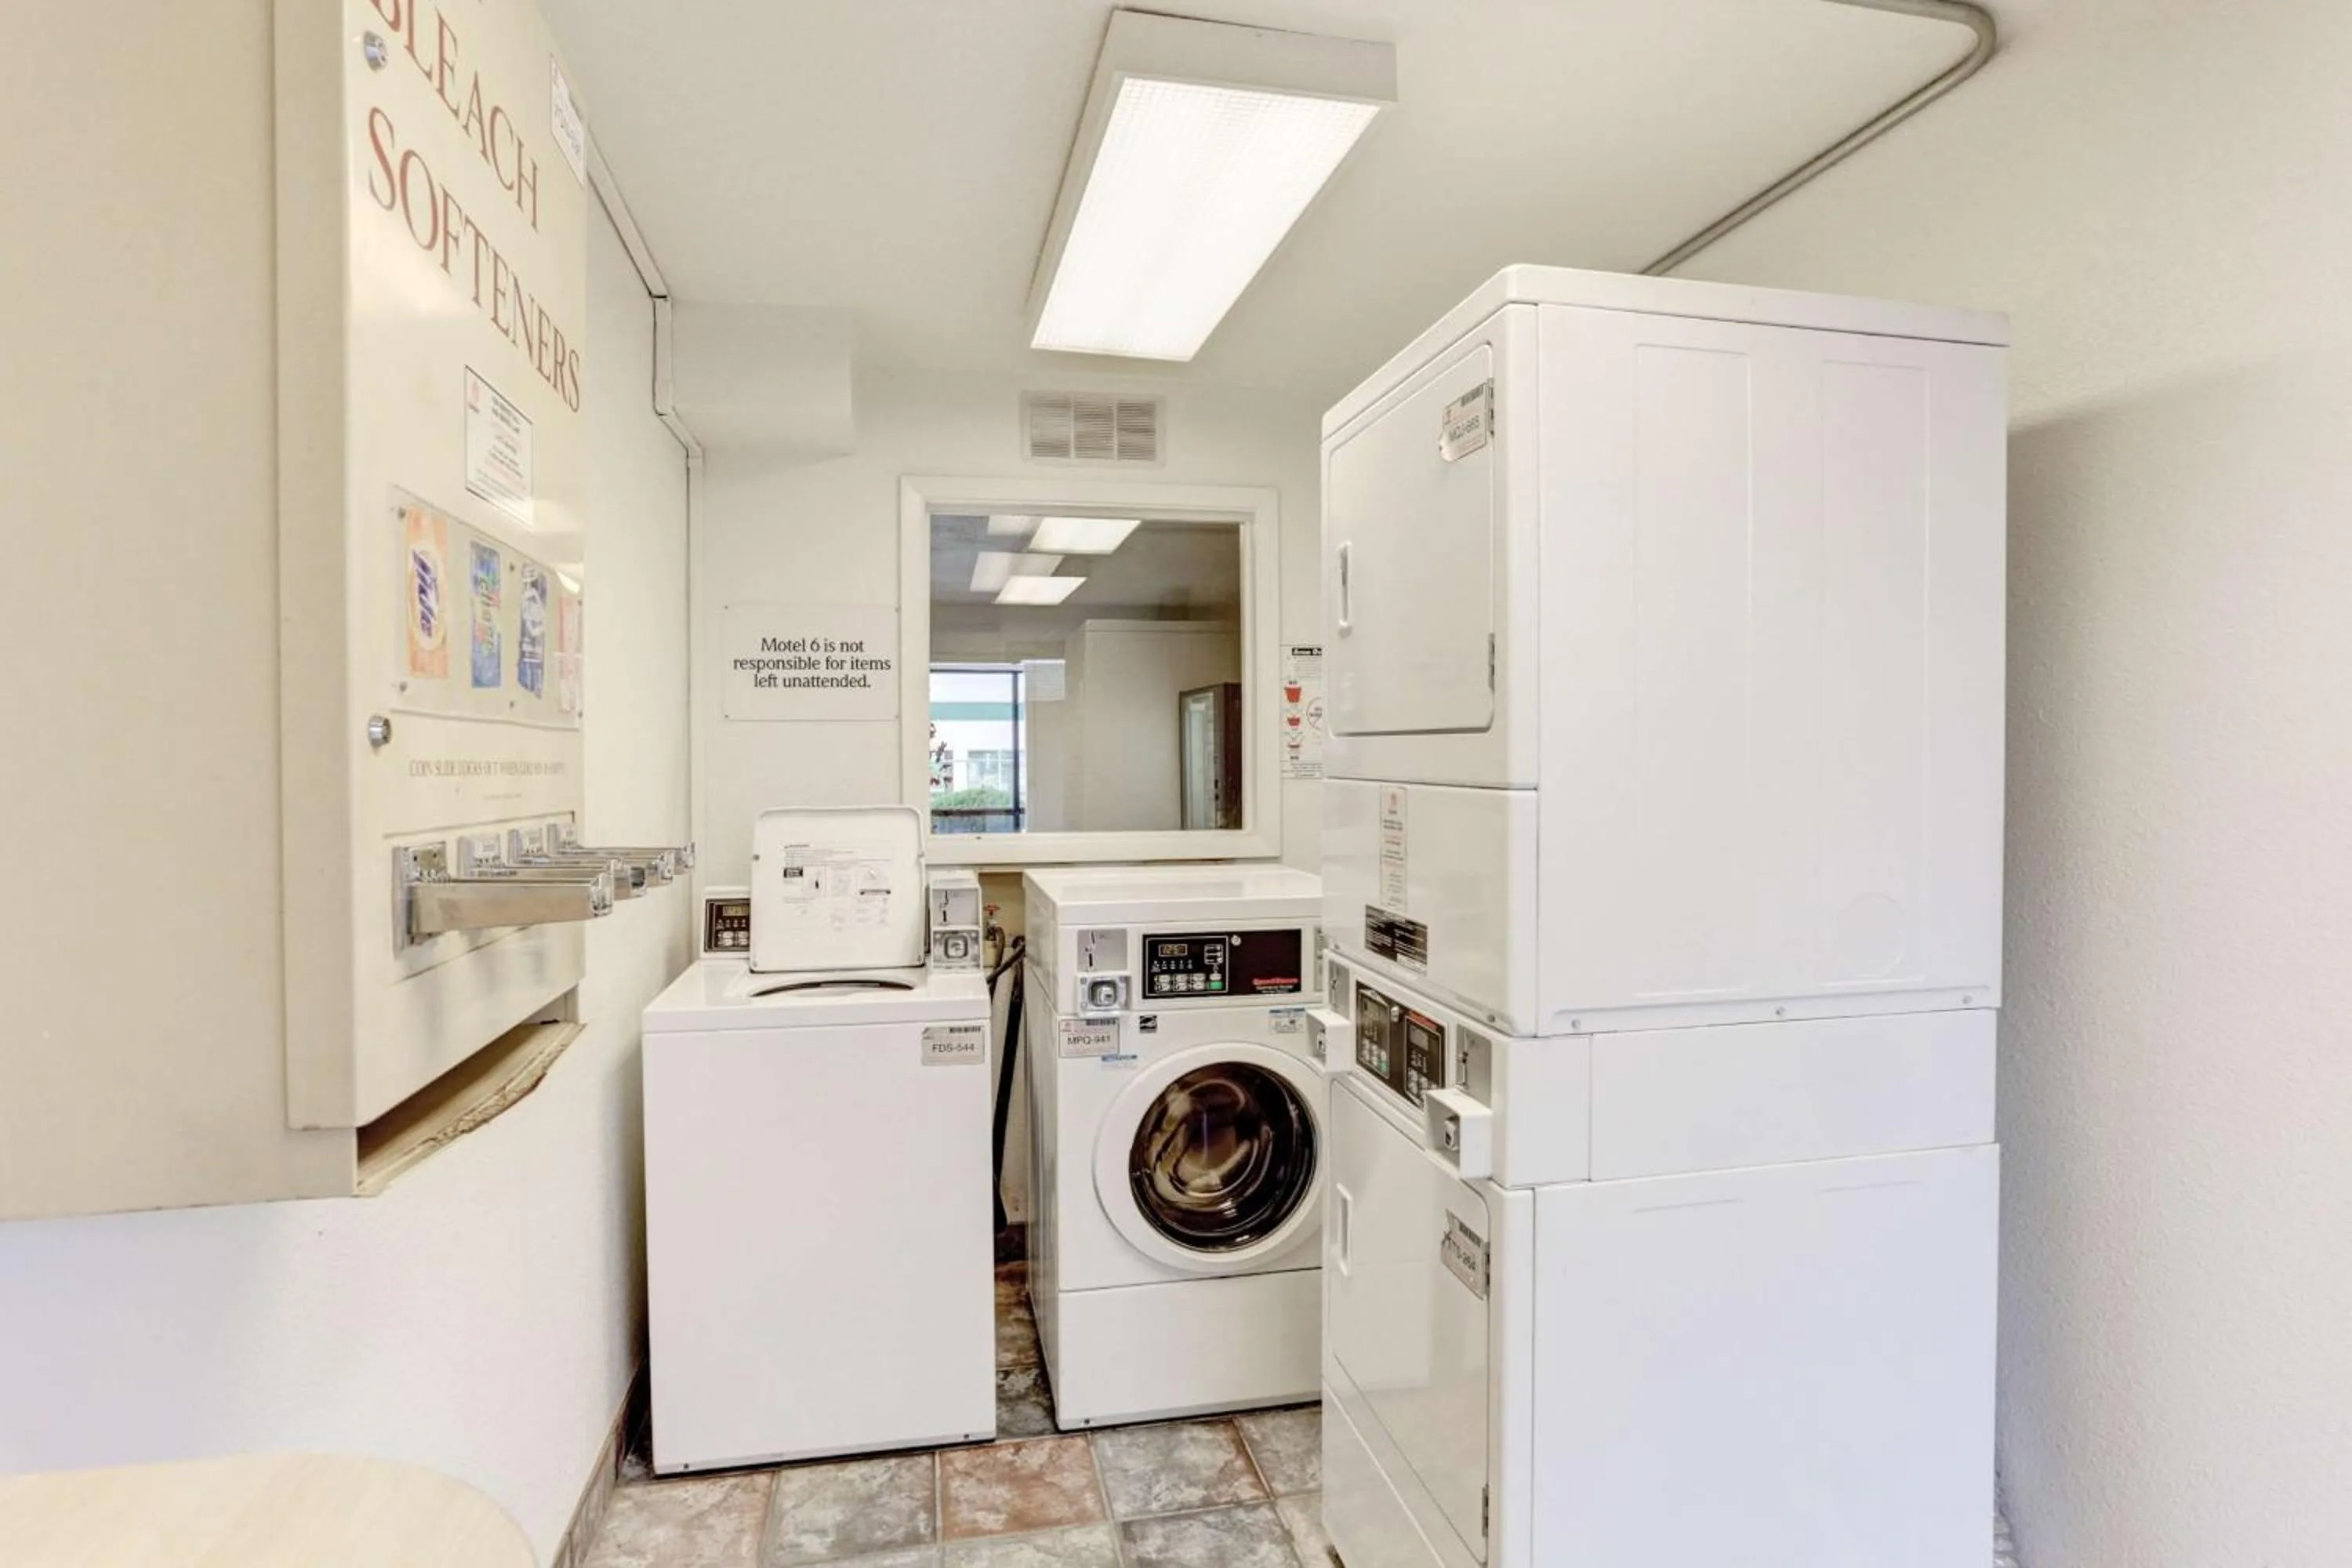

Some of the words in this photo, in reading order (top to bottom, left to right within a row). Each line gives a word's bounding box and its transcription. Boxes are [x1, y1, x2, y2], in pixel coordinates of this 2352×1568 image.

[371, 0, 538, 233] LEACH
[368, 107, 579, 413] SOFTENERS
[760, 637, 806, 653] Motel
[810, 637, 821, 653] 6
[824, 637, 836, 653] is
[840, 640, 865, 653] not
[733, 655, 821, 673] responsible
[826, 655, 848, 670] for
[850, 656, 891, 670] items
[753, 674, 779, 688] left
[783, 674, 871, 688] unattended.
